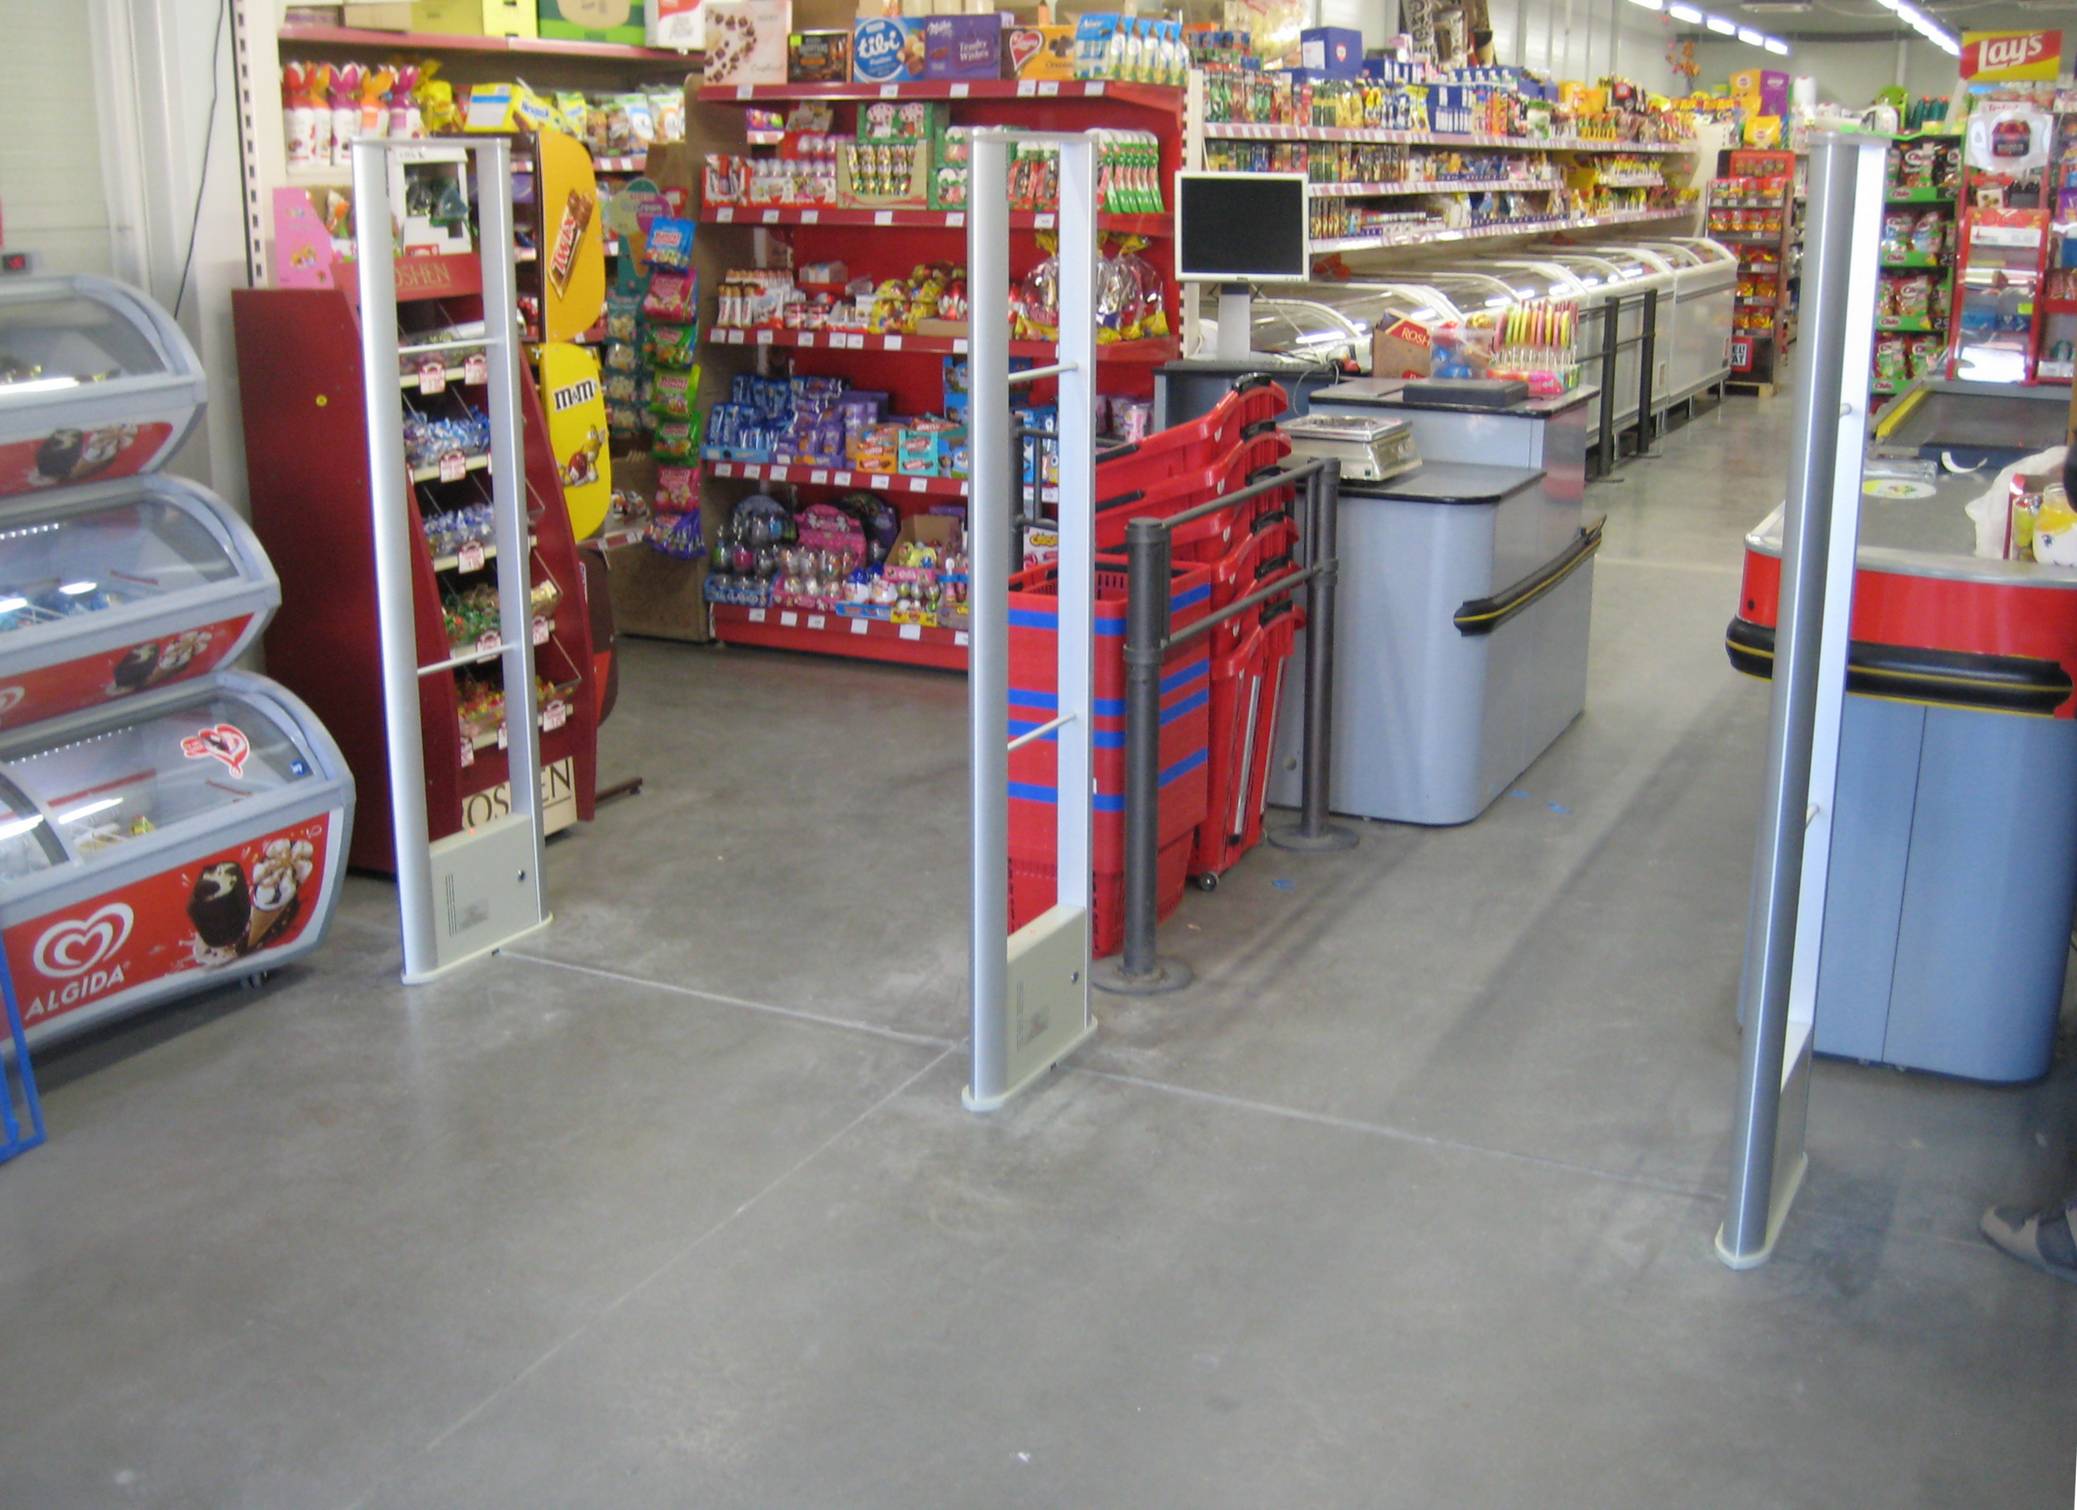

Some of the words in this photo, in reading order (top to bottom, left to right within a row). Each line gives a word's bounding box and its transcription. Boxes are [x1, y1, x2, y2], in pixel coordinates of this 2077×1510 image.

[858, 30, 899, 58] tibi
[1978, 33, 2043, 72] Lay's
[25, 964, 126, 1020] ALGIDA
